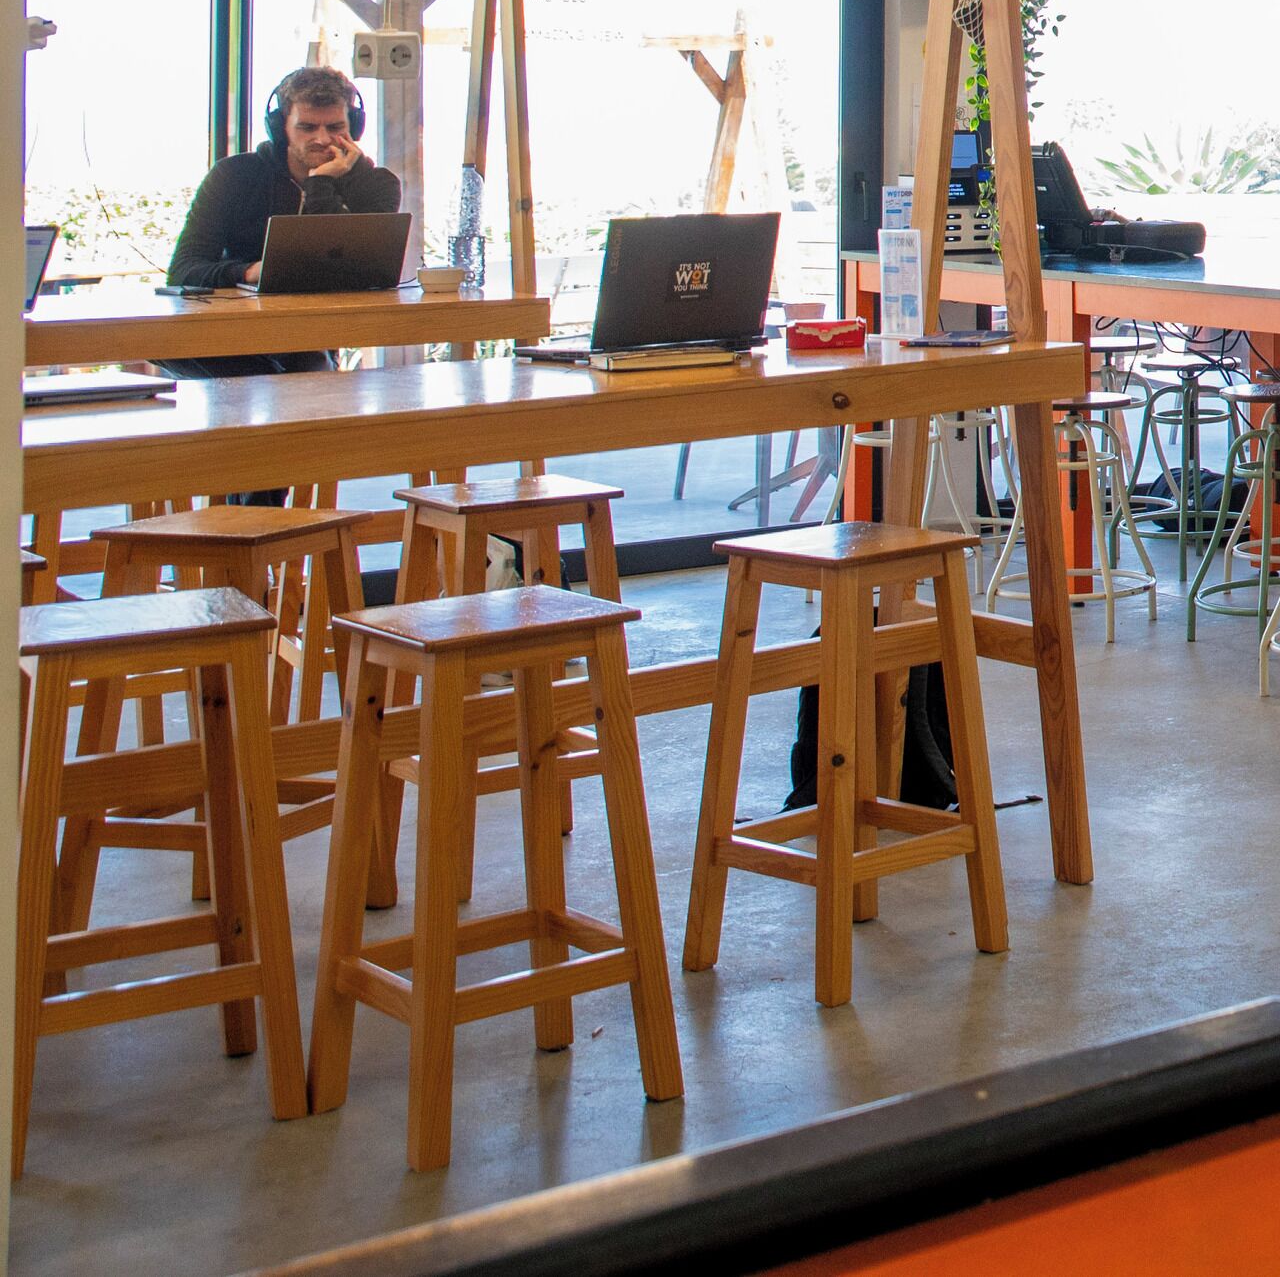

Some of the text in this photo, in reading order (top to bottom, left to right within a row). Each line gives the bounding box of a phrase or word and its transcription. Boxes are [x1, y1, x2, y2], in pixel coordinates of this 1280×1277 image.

[611, 228, 622, 273] LEGION
[680, 261, 710, 271] IT'S NOT
[675, 269, 711, 285] WOT
